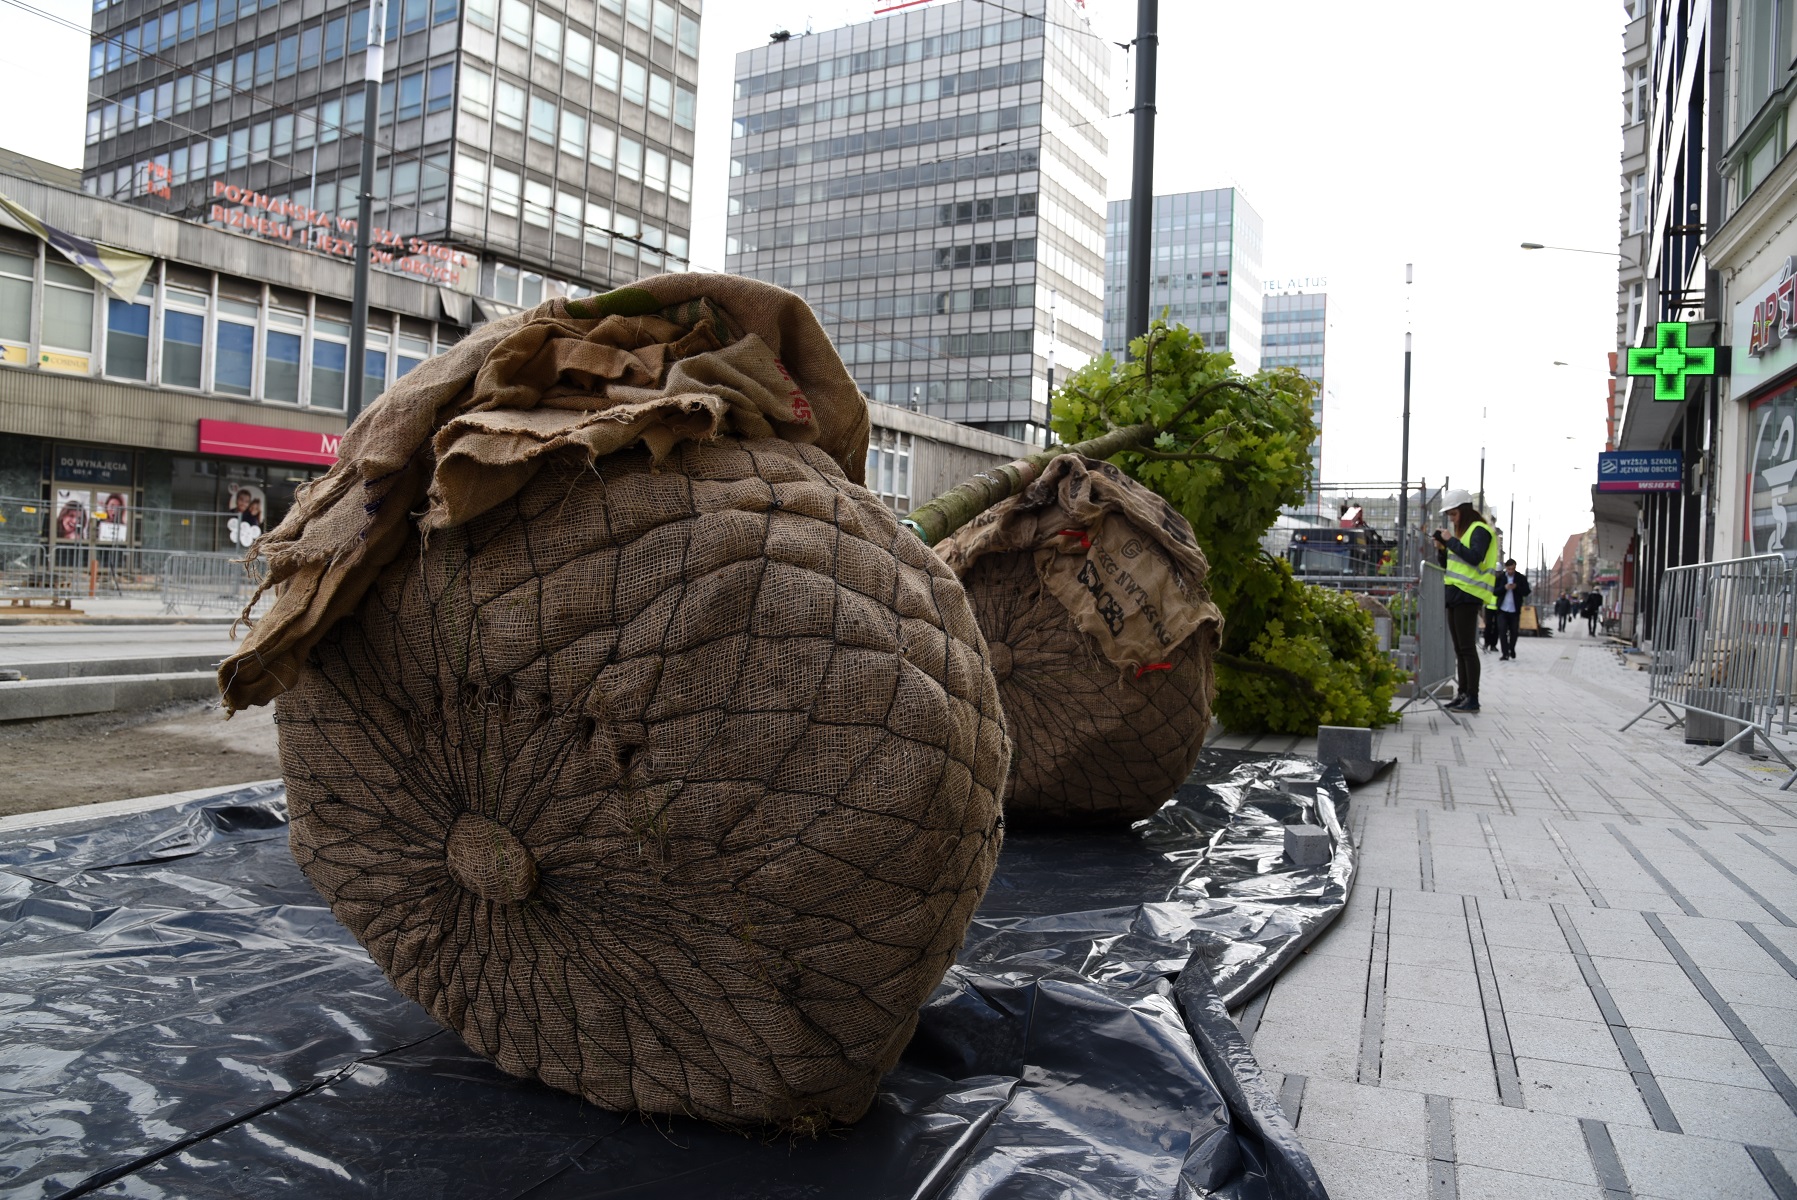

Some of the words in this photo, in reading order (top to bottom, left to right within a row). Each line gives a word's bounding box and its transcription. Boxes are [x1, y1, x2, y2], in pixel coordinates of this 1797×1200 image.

[213, 180, 330, 228] POZNAŃSKA
[336, 216, 404, 249] WYSZA
[211, 204, 293, 241] BIZNESU
[400, 256, 460, 285] OBCYCH
[1288, 277, 1327, 289] ALTUS
[61, 458, 74, 466] DO
[76, 459, 128, 471] WYNAJĘCIA
[1619, 465, 1650, 474] JĘZYKÓW
[1651, 465, 1678, 473] OBCYCH
